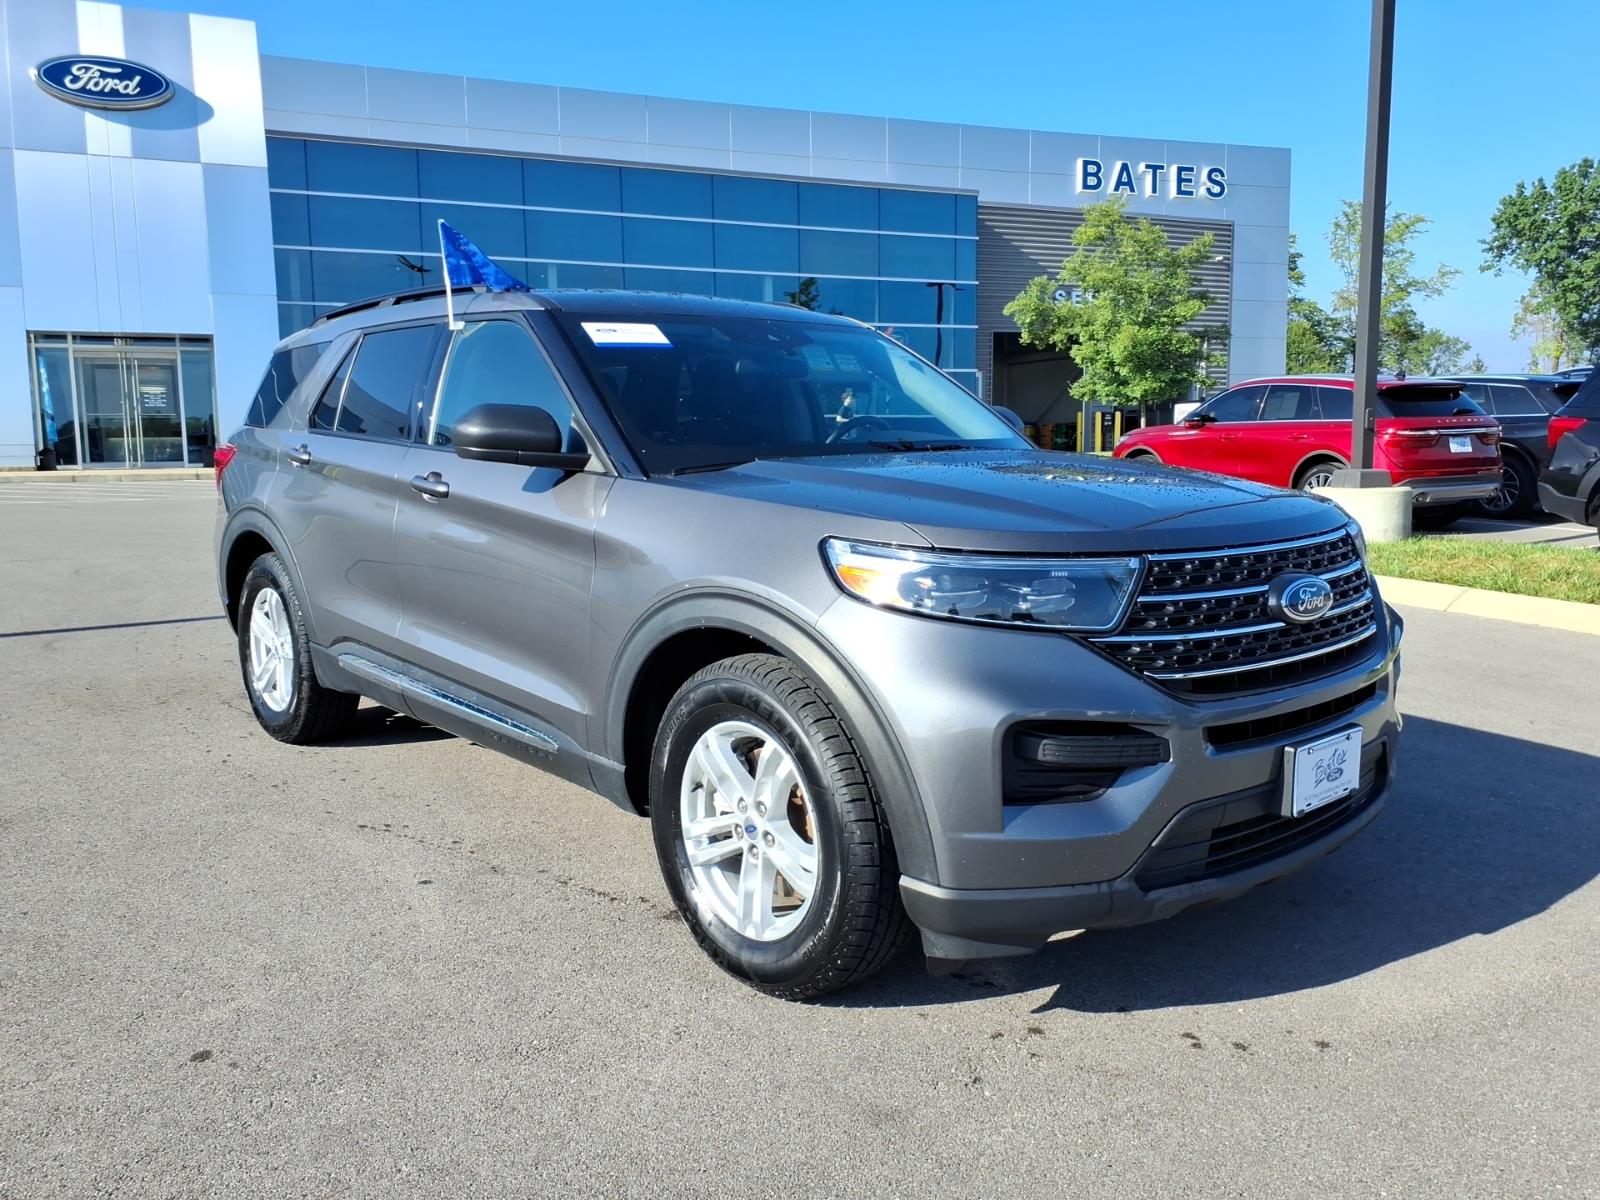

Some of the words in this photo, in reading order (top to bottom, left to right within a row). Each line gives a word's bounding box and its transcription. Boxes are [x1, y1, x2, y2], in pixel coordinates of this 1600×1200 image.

[64, 63, 141, 95] Ford
[1078, 158, 1227, 200] BATES
[1298, 587, 1325, 612] Ford
